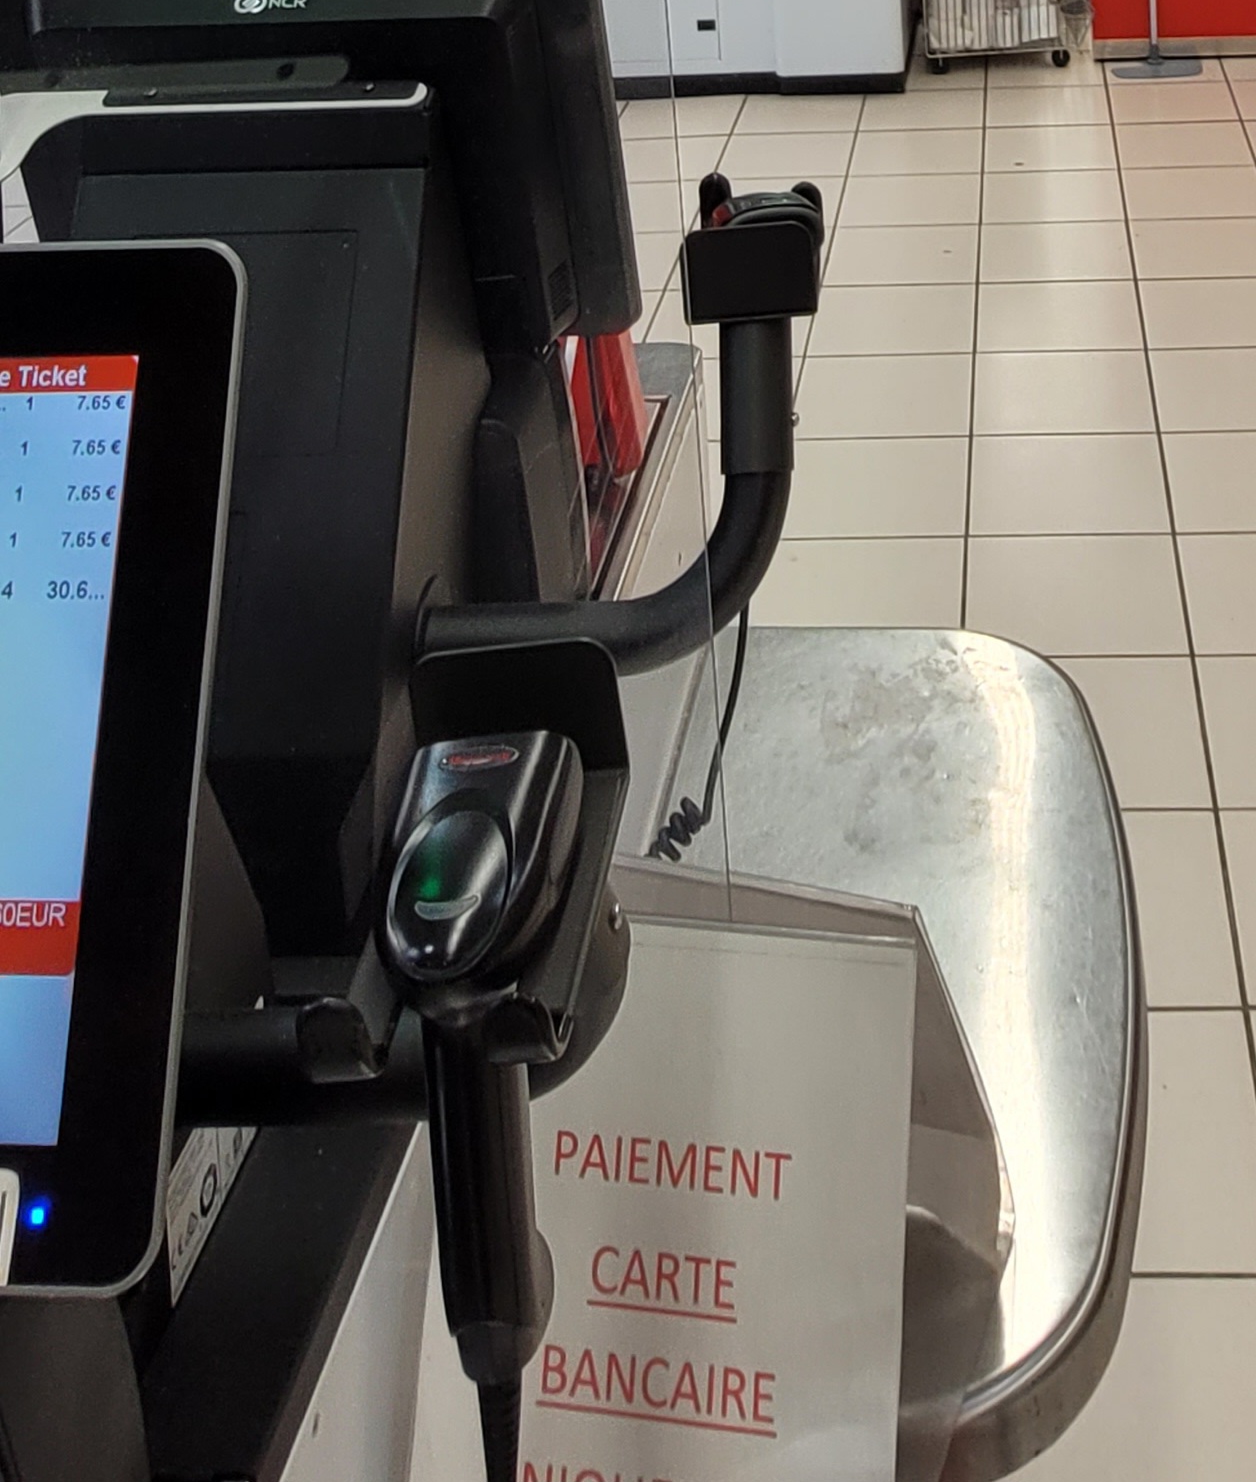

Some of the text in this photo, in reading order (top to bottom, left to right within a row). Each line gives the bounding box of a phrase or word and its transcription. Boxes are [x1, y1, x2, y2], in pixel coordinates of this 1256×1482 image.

[19, 364, 88, 387] Ticket
[26, 395, 126, 411] 1 7.65 €
[21, 439, 121, 456] 1 7.65 €
[15, 484, 117, 502] 1 7.65 €
[9, 531, 111, 548] 1 7.65 €
[1, 580, 105, 600] 4 30.6...
[0, 902, 66, 927] 0EUR
[554, 1129, 792, 1201] PAIEMENT
[591, 1245, 737, 1310] CARTE
[541, 1344, 776, 1424] BANCAIRE
